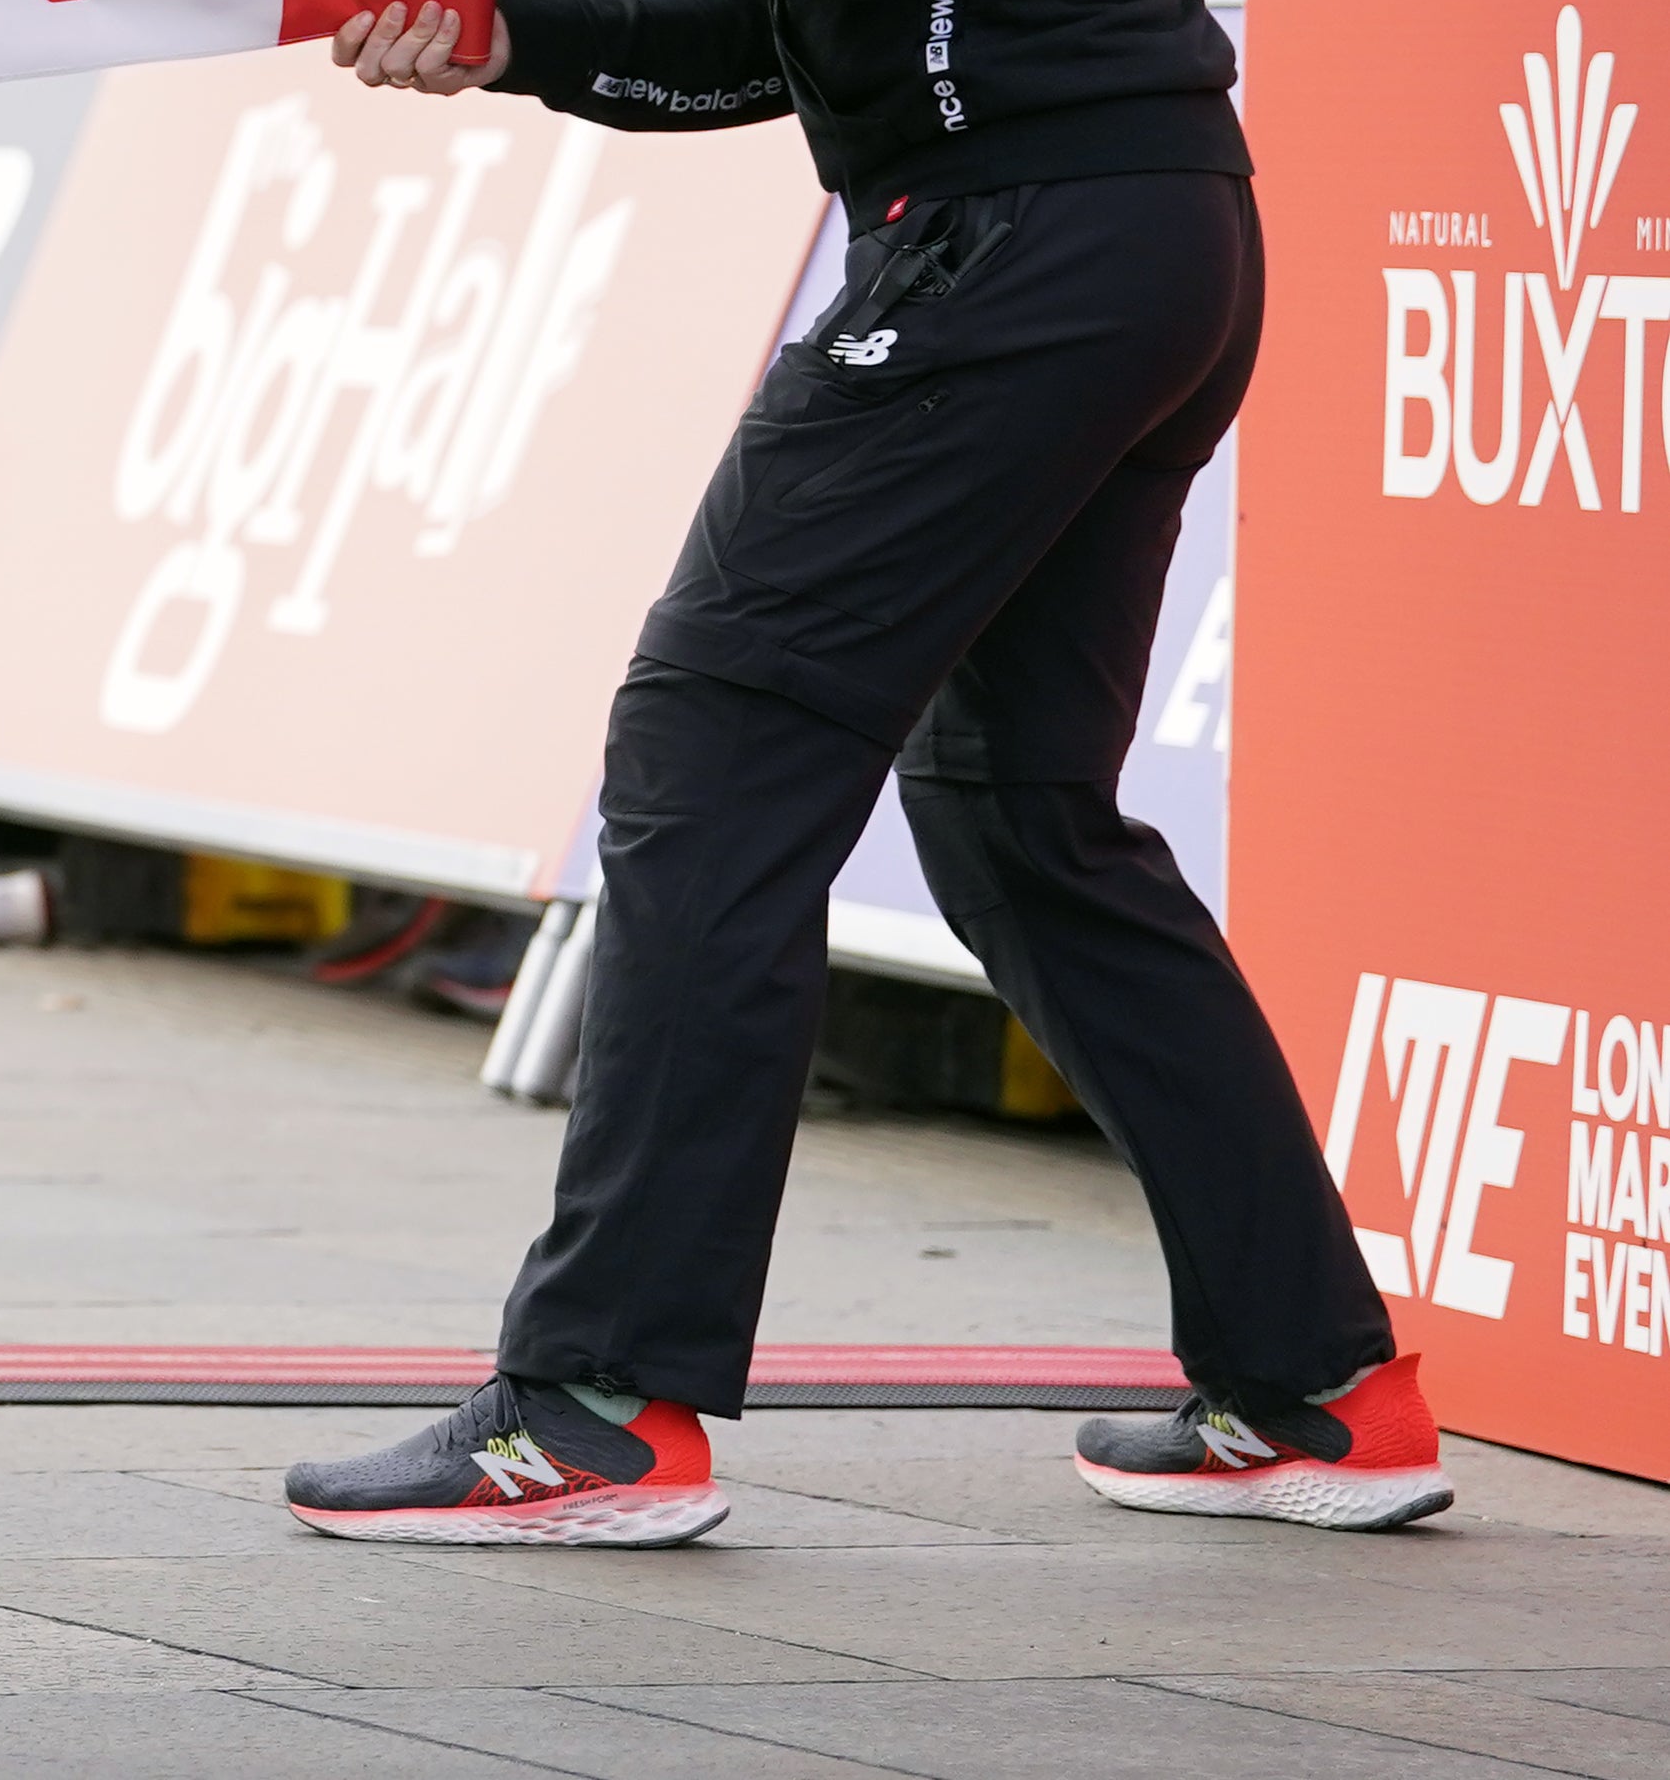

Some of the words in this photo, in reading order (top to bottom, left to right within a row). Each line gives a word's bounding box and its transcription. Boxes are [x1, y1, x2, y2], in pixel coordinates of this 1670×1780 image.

[1389, 211, 1493, 249] NATURAL
[1637, 217, 1670, 252] MI
[1381, 267, 1670, 514] BUXT
